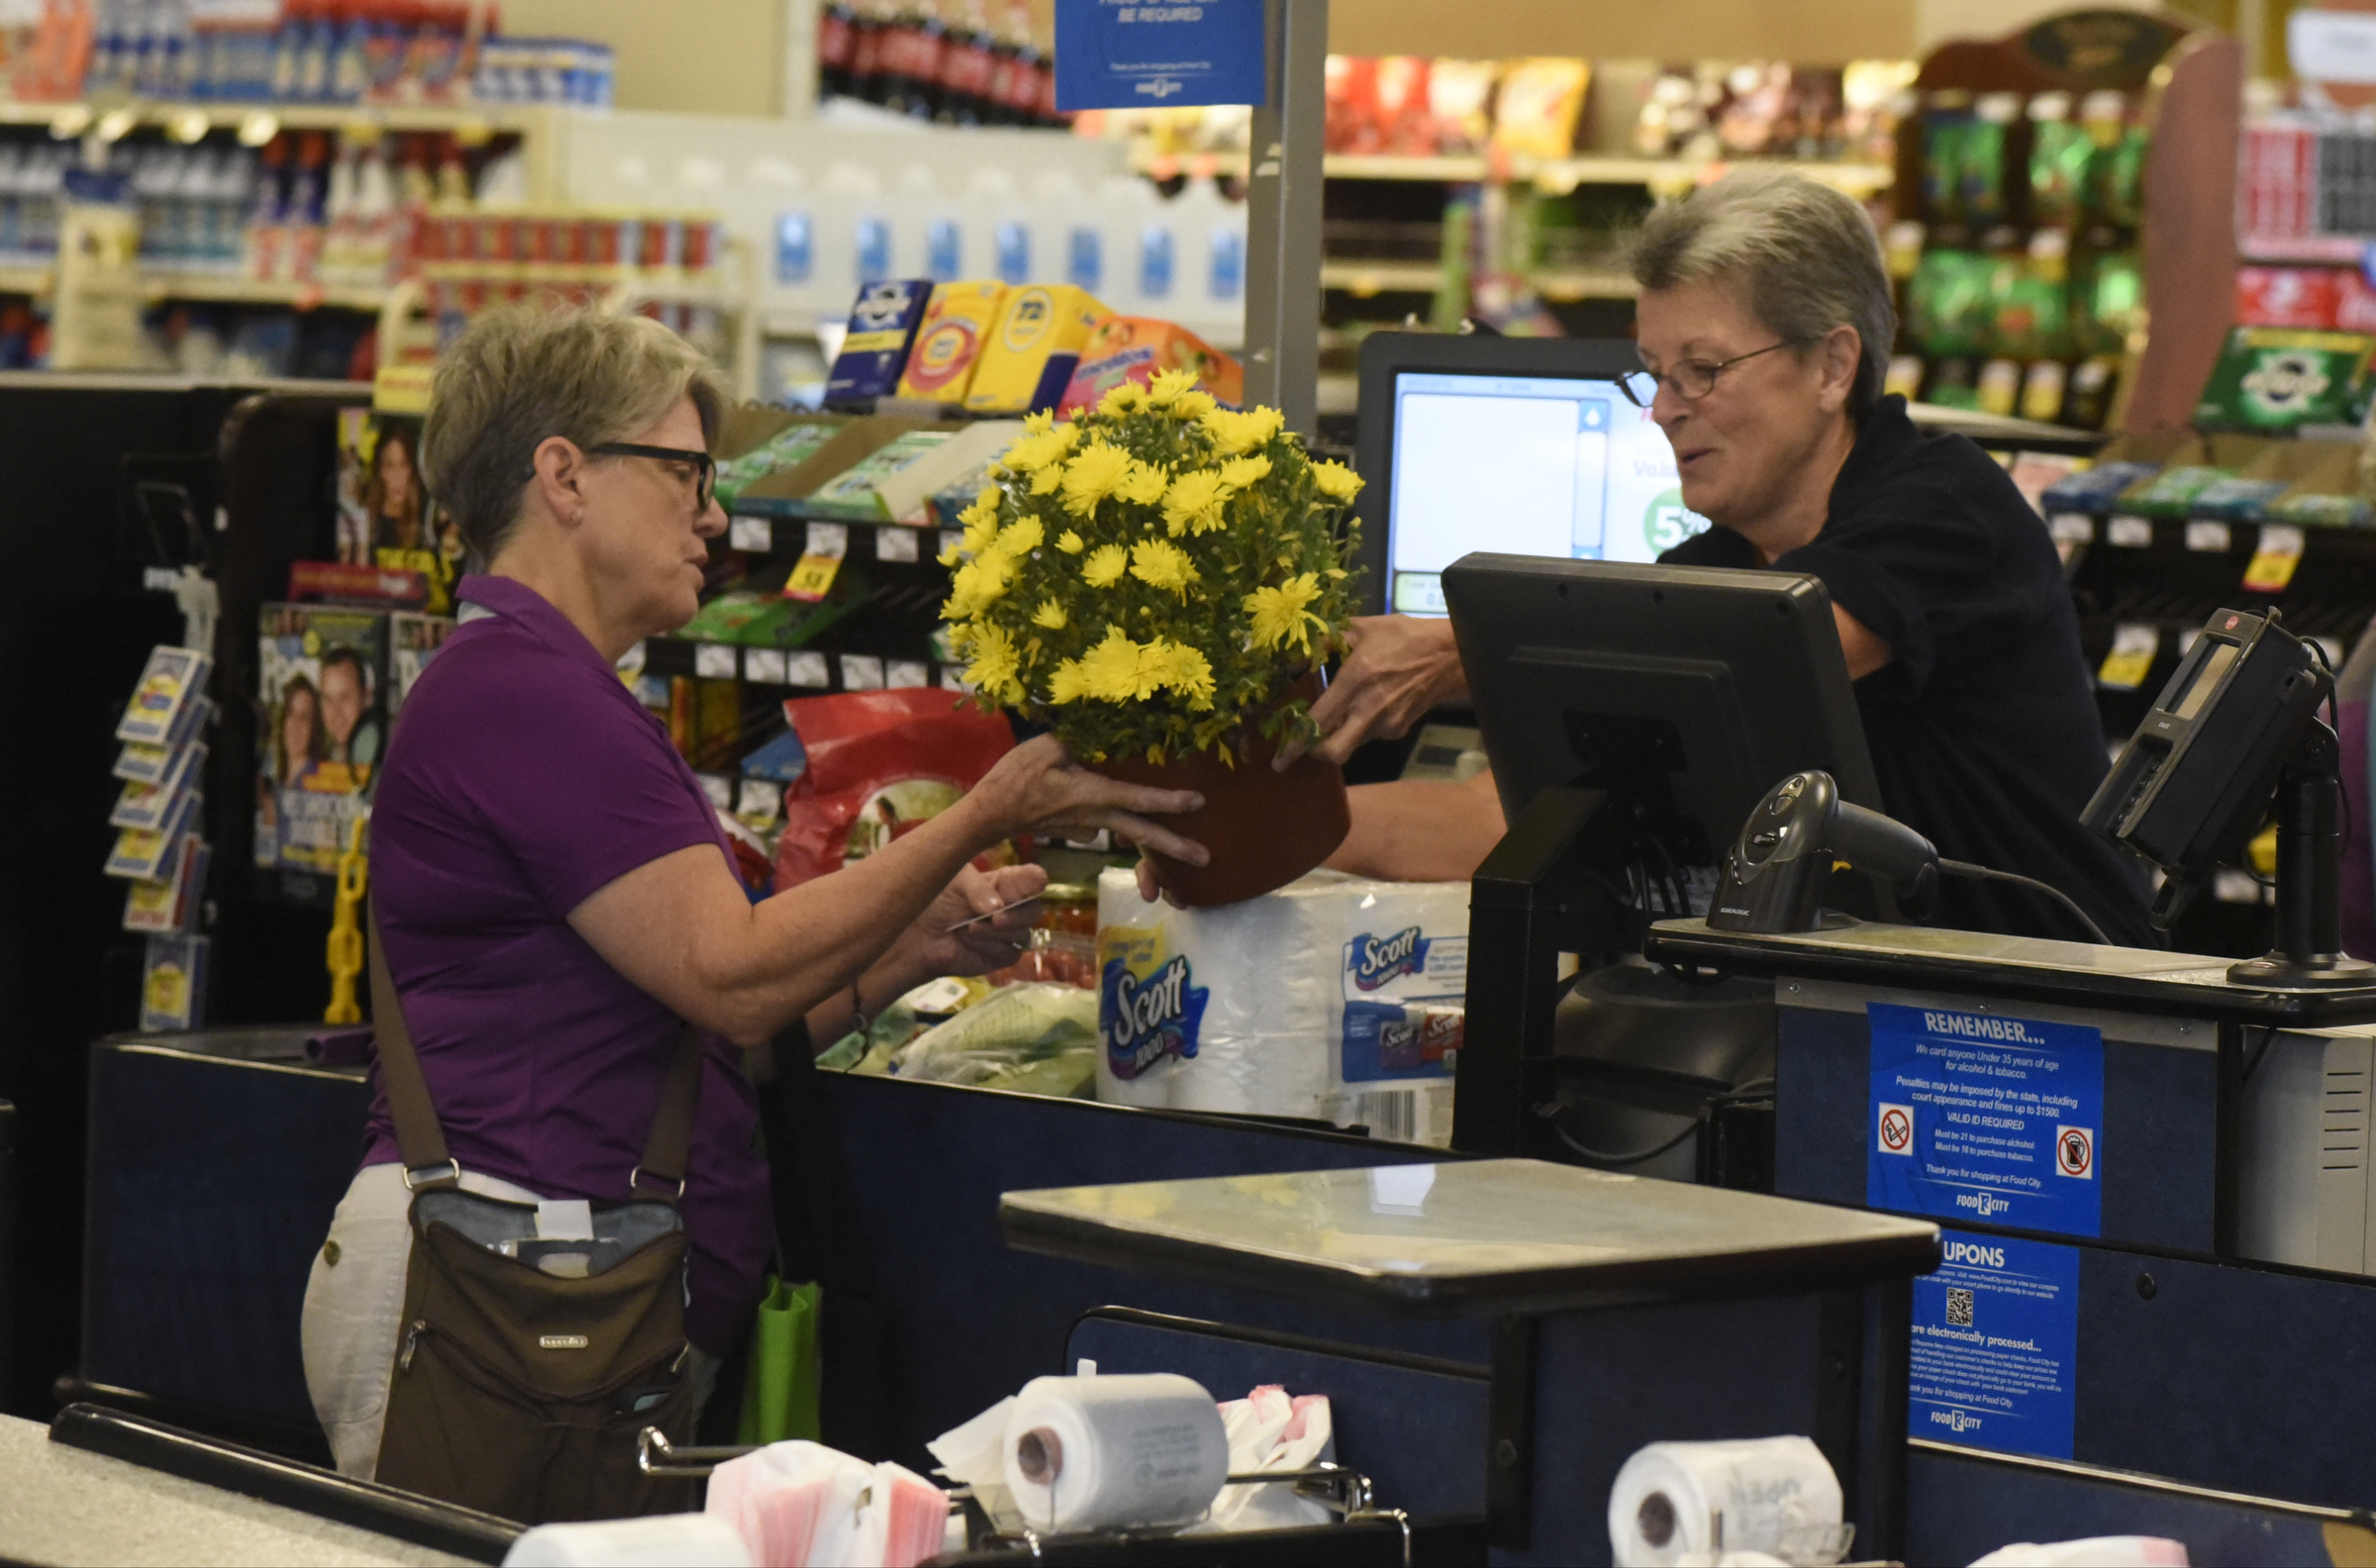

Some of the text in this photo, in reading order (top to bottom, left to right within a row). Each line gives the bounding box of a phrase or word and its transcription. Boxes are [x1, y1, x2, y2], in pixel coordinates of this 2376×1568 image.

[1361, 927, 1417, 975] Scott
[1115, 957, 1186, 1045] Scott
[1925, 1013, 2044, 1044] REMEMBER...
[1917, 1044, 2059, 1071] We card anyone Under 35 years of age
[1945, 1060, 2027, 1078] for alcohol & tobacco.
[1896, 1075, 1930, 1089] Penalties
[1931, 1082, 1948, 1093] may
[1949, 1082, 1959, 1092] be
[1960, 1084, 1994, 1096] imposed
[1995, 1088, 2005, 1100] by
[2006, 1090, 2019, 1099] the
[2042, 1094, 2078, 1109] including
[1912, 1093, 1932, 1102] court
[1932, 1095, 1977, 1107] appearance
[1978, 1100, 1993, 1109] and
[1995, 1101, 2013, 1112] fines
[2015, 1106, 2026, 1115] up
[2027, 1106, 2034, 1115] to
[1947, 1112, 2025, 1130] VALID ID REQUIRED
[1934, 1128, 1950, 1138] Must
[1975, 1136, 2006, 1145] purchase
[1935, 1141, 1951, 1151] Must
[1977, 1149, 2006, 1158] purchase
[1927, 1164, 1946, 1174] Thank
[1960, 1168, 1969, 1177] for
[1971, 1171, 2001, 1184] shopping
[2010, 1175, 2028, 1185] Food
[1956, 1195, 1977, 1208] FOOD
[1991, 1198, 2009, 1212] CITY
[1944, 1241, 2004, 1267] UPONS
[1928, 1324, 1985, 1345] electronically
[1988, 1336, 2041, 1351] processed...
[1945, 1390, 1974, 1402] shopping
[1982, 1395, 1999, 1405] Food
[1930, 1411, 1951, 1424] FOOD
[1964, 1418, 1982, 1429] CITY
